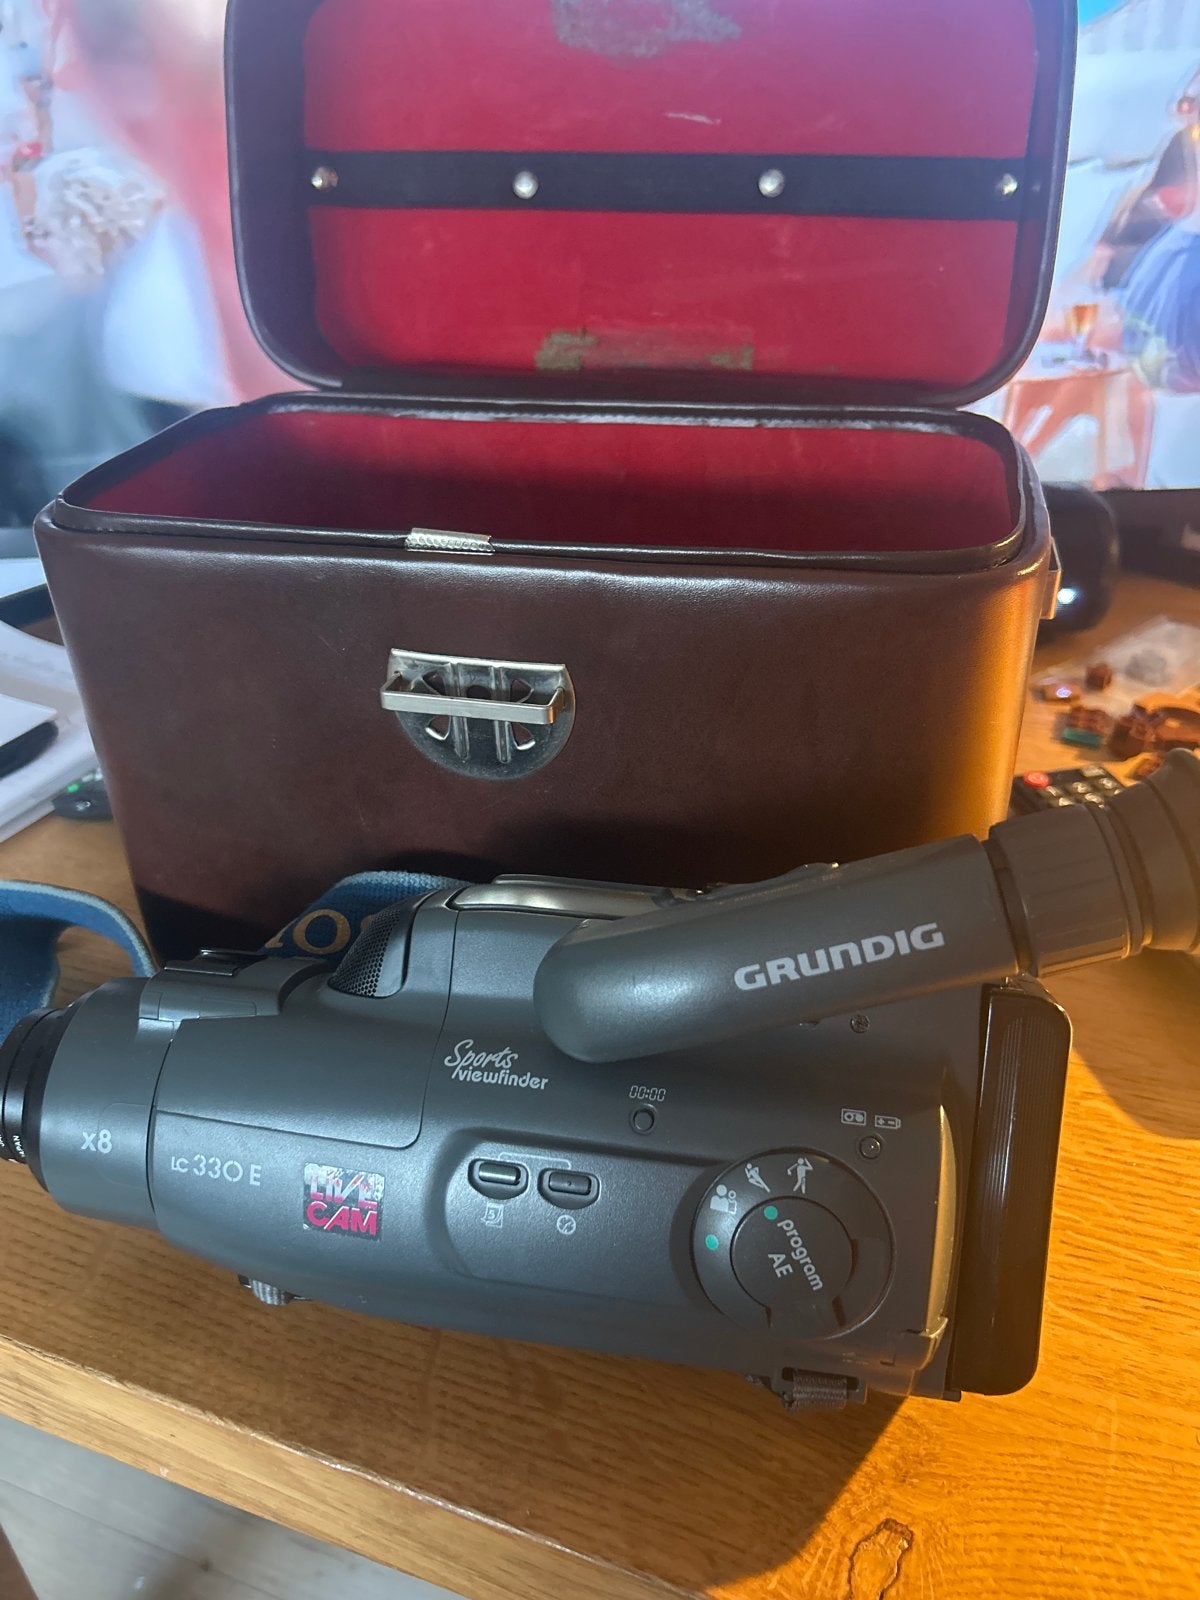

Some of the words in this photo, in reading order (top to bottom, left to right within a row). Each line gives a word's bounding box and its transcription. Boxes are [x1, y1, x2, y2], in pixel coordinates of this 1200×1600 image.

[734, 922, 945, 991] GRUNDIG
[444, 1039, 518, 1079] Sports
[456, 1067, 549, 1090] viewfinder
[629, 1085, 666, 1102] 00:00
[306, 1201, 378, 1236] CAM
[767, 1253, 794, 1278] AE
[777, 1219, 824, 1292] program
